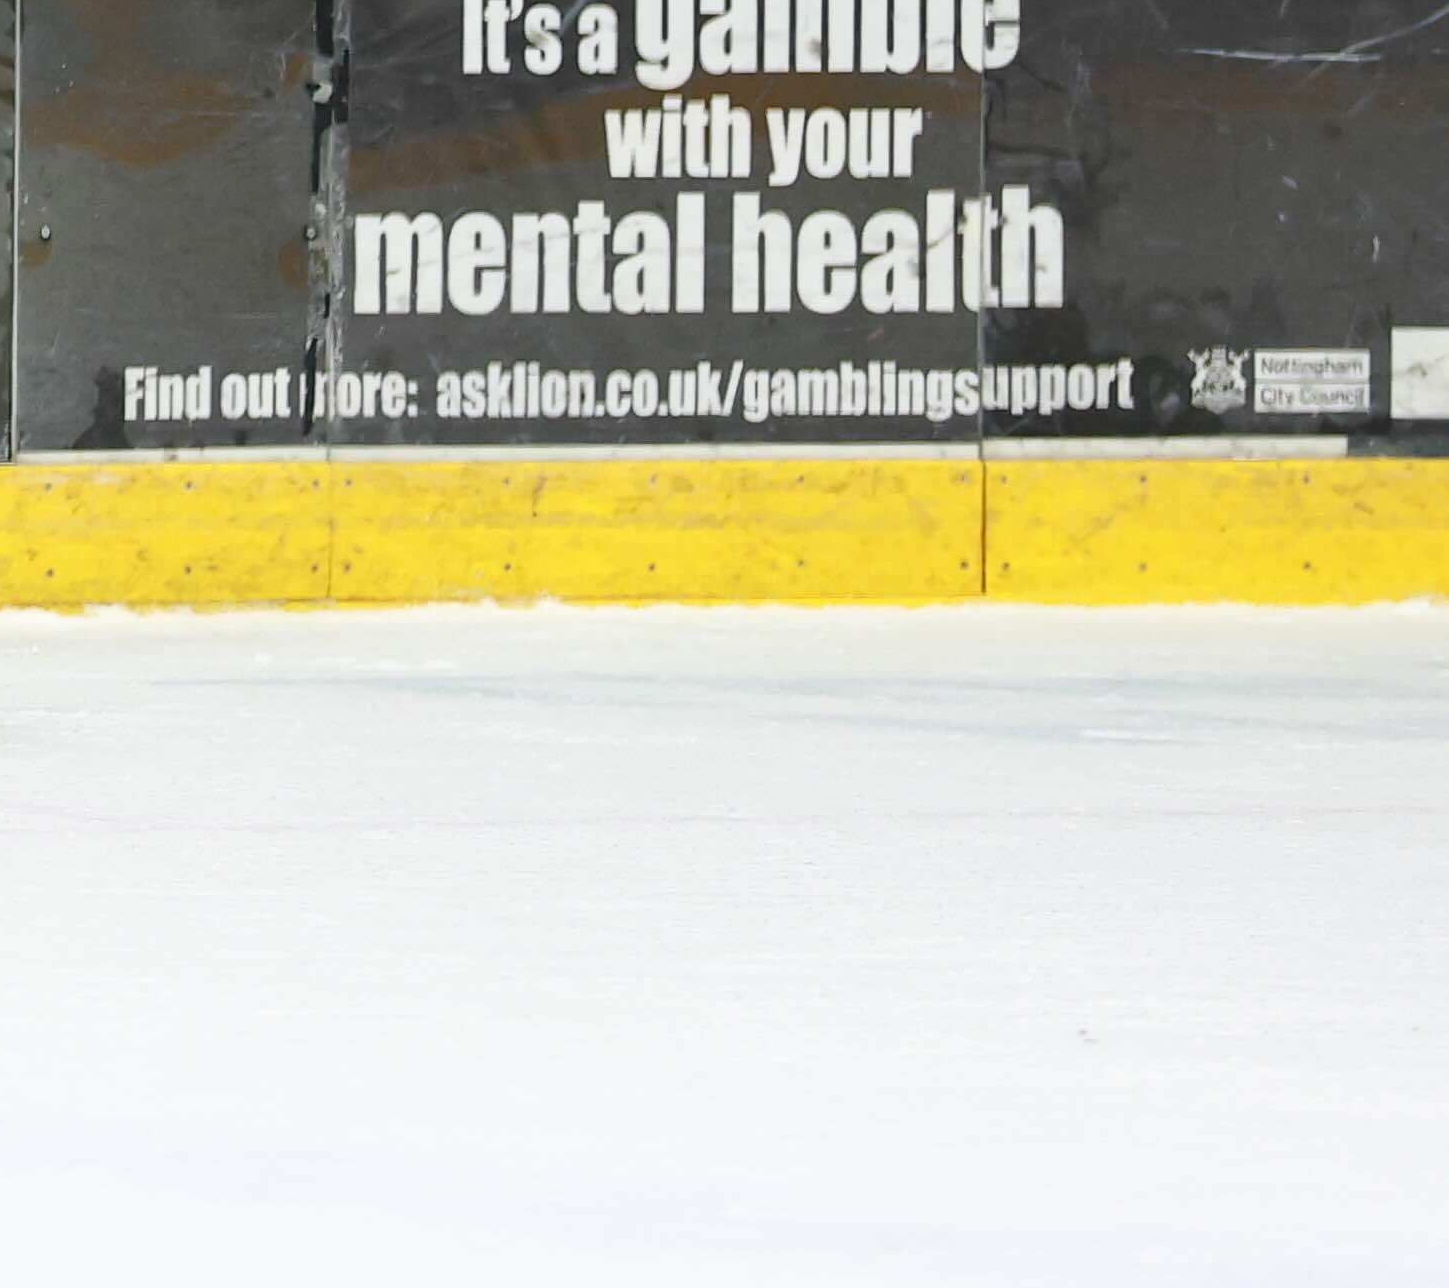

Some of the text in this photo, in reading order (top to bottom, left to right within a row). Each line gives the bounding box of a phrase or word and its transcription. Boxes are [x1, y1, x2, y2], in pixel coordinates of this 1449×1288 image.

[577, 2, 619, 75] a
[603, 93, 924, 186] with your
[352, 184, 1065, 315] mental health
[123, 365, 212, 422] Find
[222, 369, 292, 421] out
[435, 359, 1135, 424] asklion.co.uk/gamblingsupport
[1259, 356, 1365, 378] Nottingham
[1259, 386, 1365, 406] City Council
